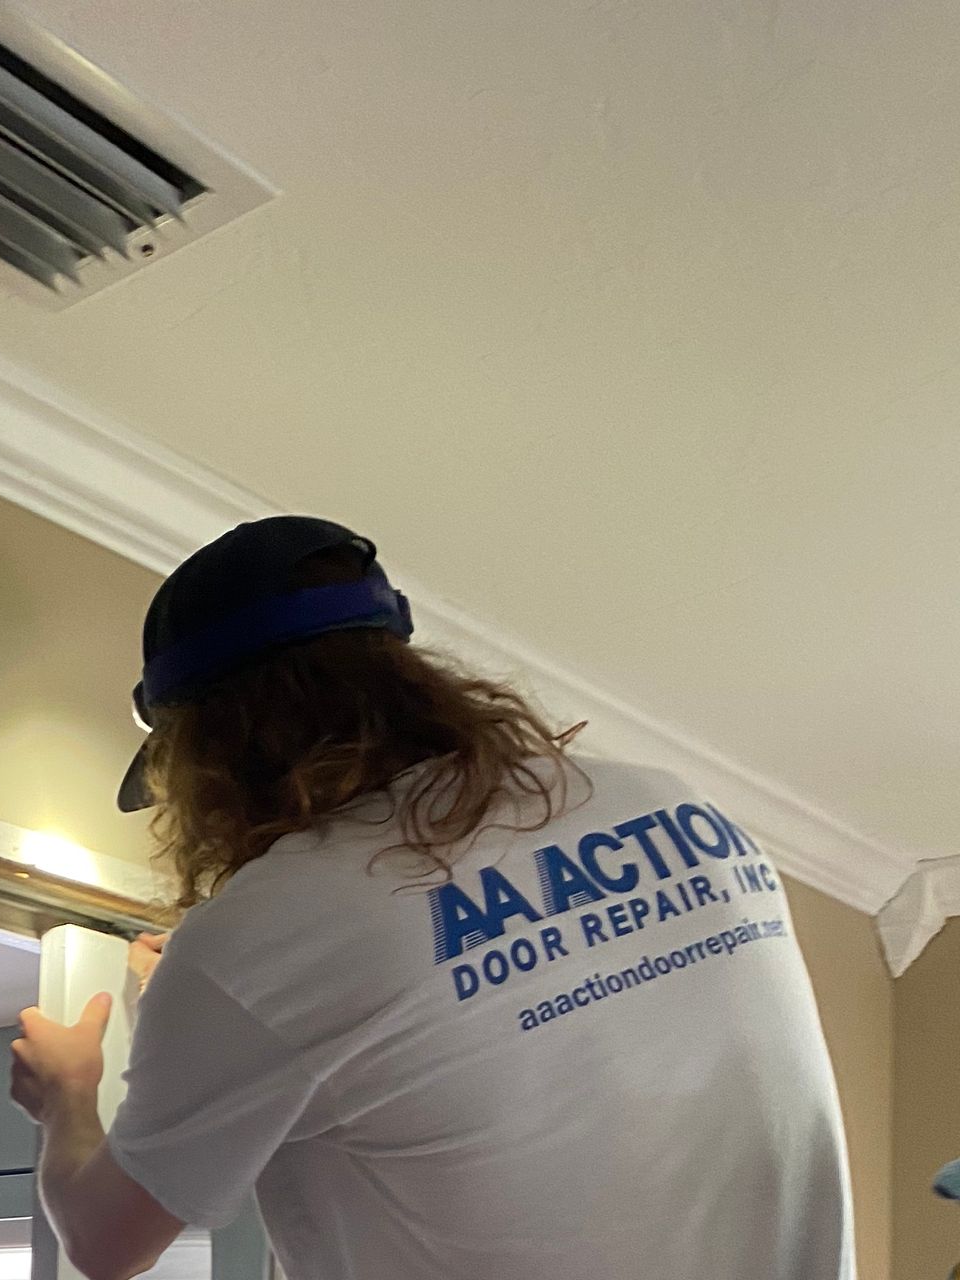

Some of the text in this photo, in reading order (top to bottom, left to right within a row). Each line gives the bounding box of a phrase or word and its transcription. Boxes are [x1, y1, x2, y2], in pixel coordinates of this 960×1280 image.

[426, 866, 543, 966] AA
[452, 926, 569, 1001] DOOR
[581, 875, 730, 947] REPAIR,
